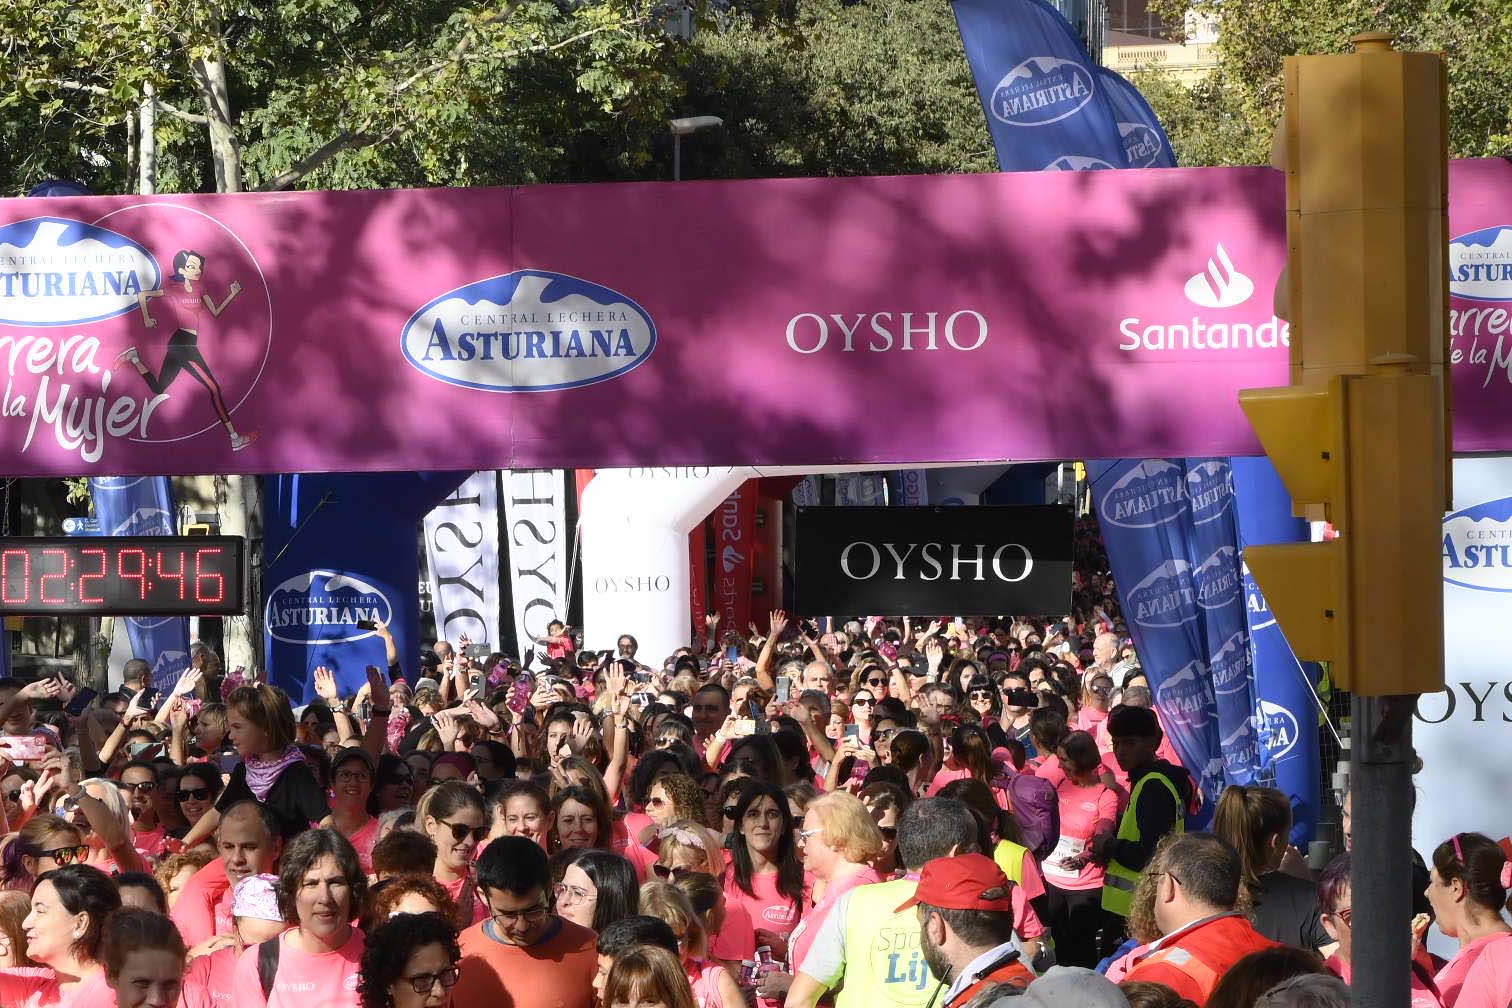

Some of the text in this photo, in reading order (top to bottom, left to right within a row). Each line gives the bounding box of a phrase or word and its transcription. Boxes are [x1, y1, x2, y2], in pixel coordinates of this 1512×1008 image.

[461, 310, 629, 326] CENTRAL LECHERA
[785, 309, 989, 355] OYSHO
[422, 316, 638, 363] ASTURIANA
[1469, 336, 1487, 365] la
[1, 379, 26, 418] la
[21, 369, 170, 463] Mujer
[1467, 530, 1512, 540] CENT
[1, 549, 224, 603] 02:29:46
[840, 541, 1034, 582] OYSHO
[595, 575, 671, 593] OYSHO
[270, 602, 381, 628] ASTURIANA
